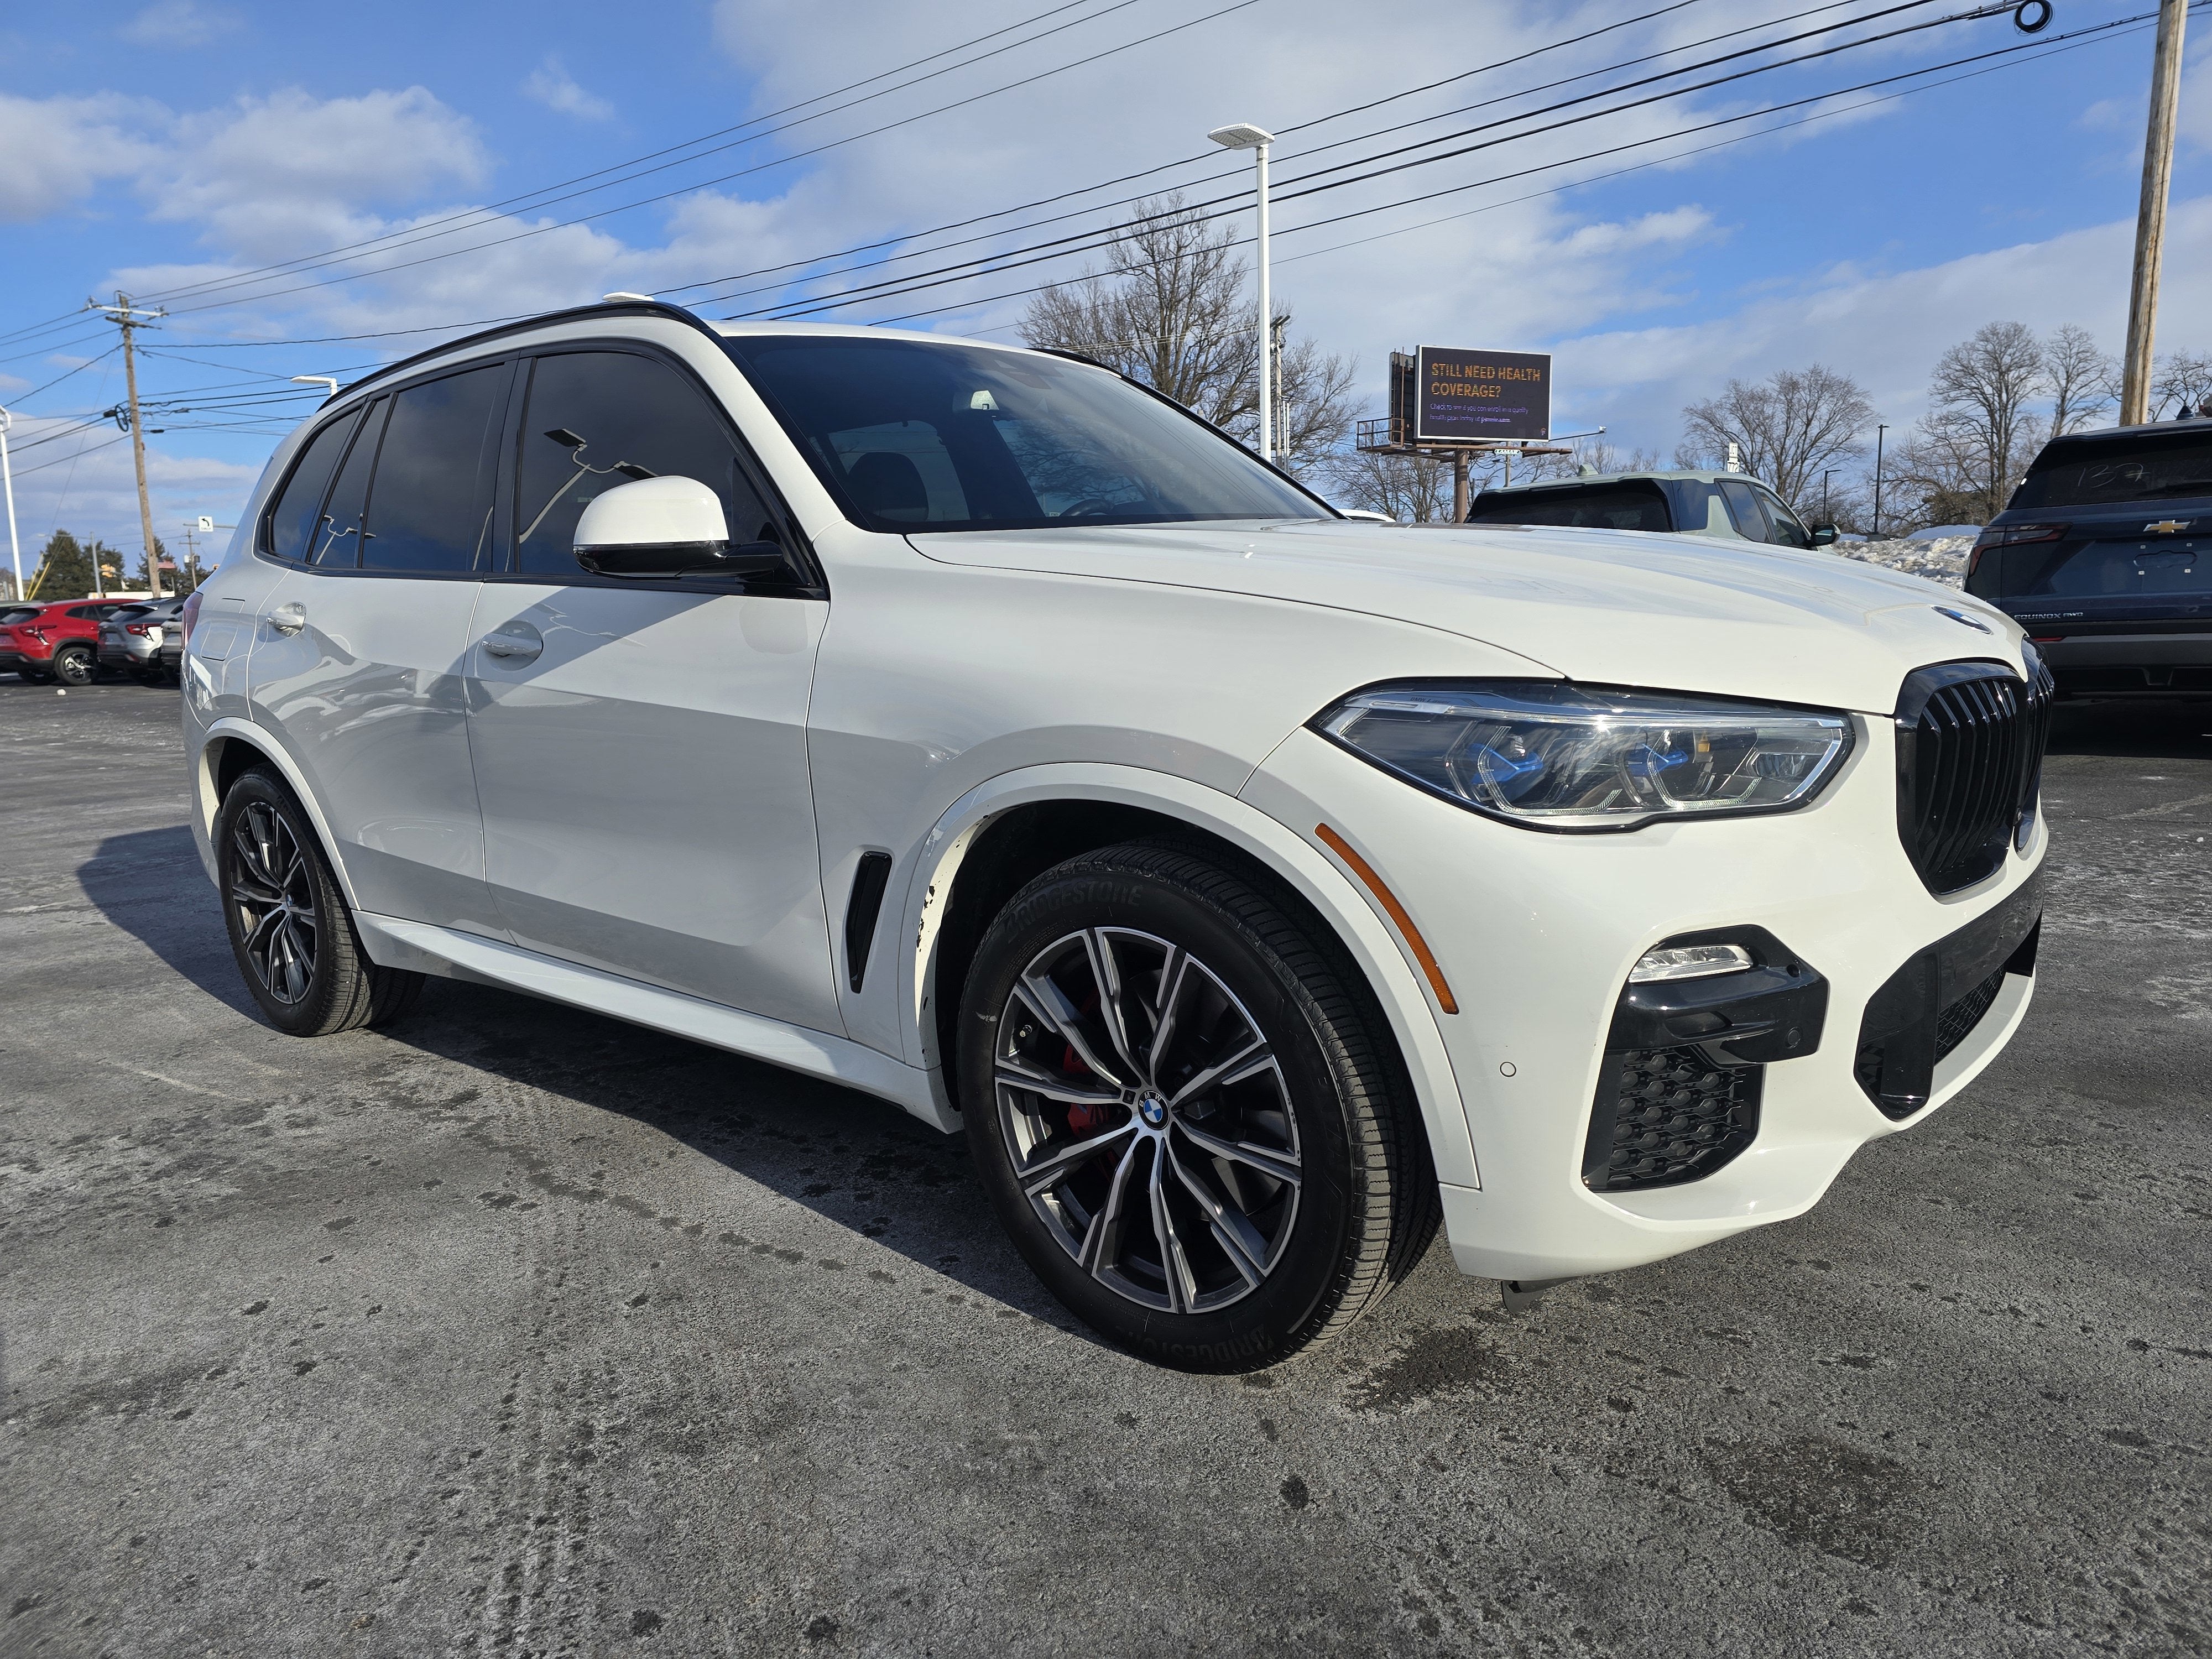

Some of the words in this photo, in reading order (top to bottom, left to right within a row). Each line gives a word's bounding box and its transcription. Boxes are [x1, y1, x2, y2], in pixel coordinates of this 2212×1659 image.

[1431, 363, 1462, 377] STILL
[1465, 365, 1495, 379] NEED
[1498, 367, 1541, 382] HEALTH
[1431, 382, 1501, 398] COVERAGE?
[1139, 1092, 1162, 1108] BMW
